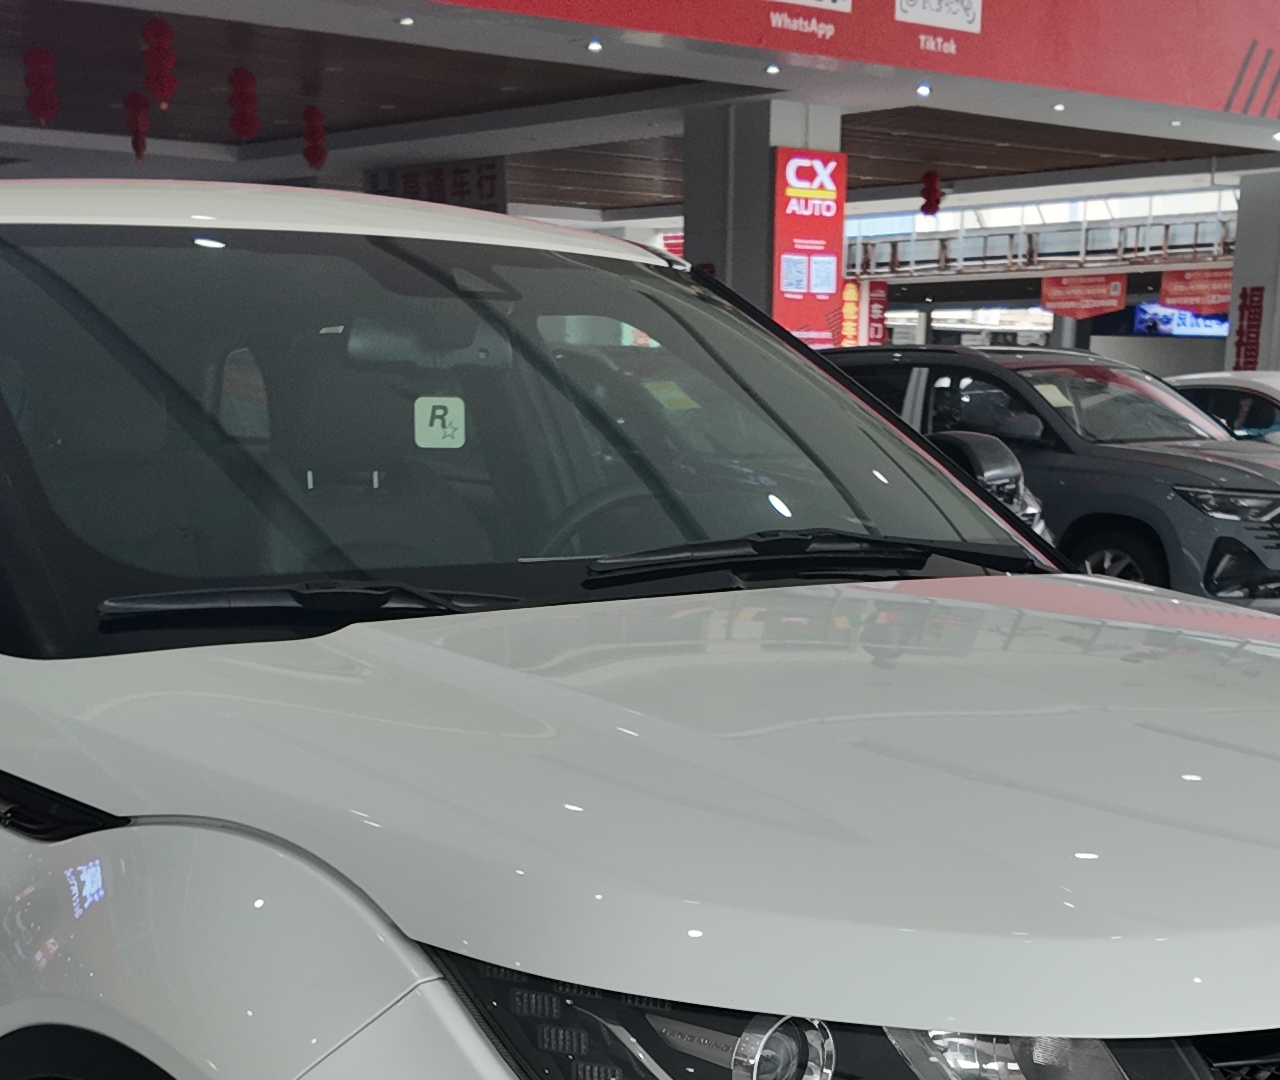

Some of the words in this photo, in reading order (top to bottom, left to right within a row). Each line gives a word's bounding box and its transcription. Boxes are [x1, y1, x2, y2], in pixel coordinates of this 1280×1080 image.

[770, 11, 835, 39] WhatsApp
[918, 34, 957, 54] TikTok
[785, 157, 838, 191] CX
[785, 198, 837, 217] AUTO
